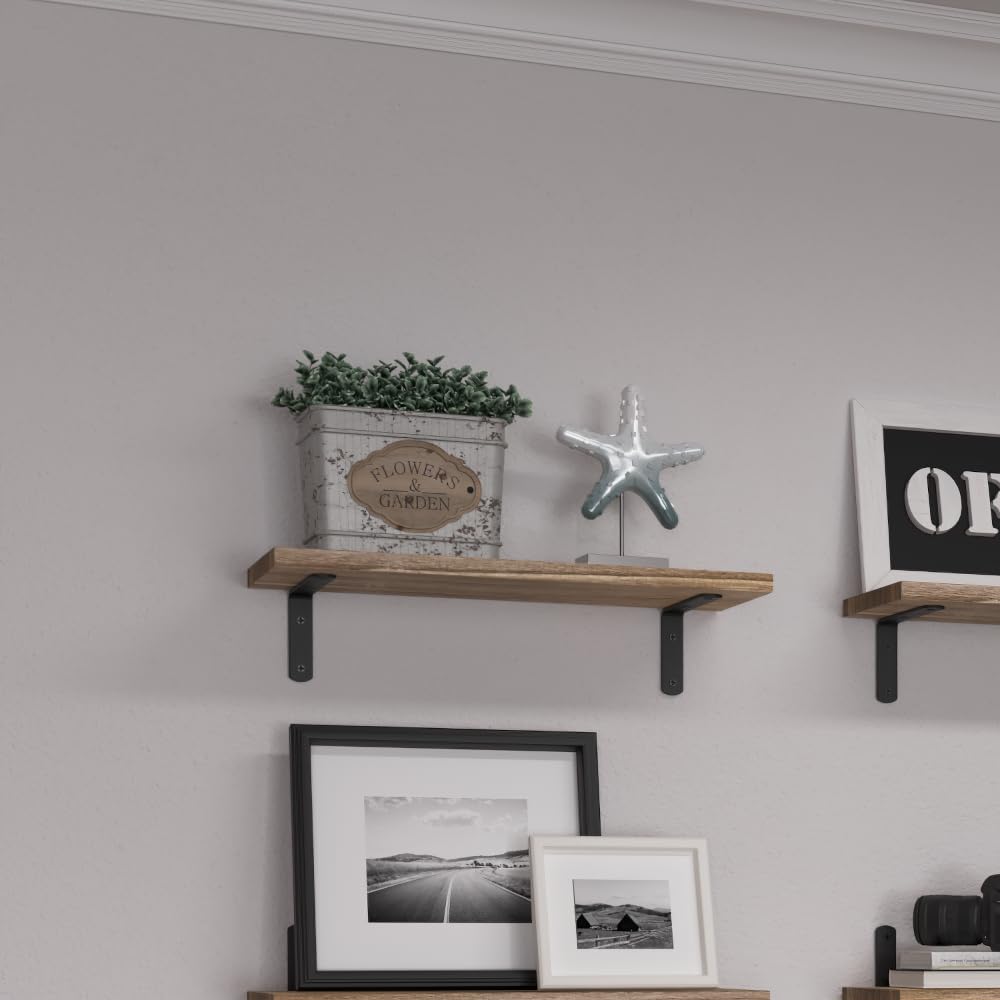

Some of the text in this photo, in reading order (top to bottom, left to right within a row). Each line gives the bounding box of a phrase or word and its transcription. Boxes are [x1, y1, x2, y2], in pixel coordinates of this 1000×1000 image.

[369, 460, 460, 490] FLOWERS
[409, 477, 422, 493] &
[379, 493, 450, 512] GARDEN
